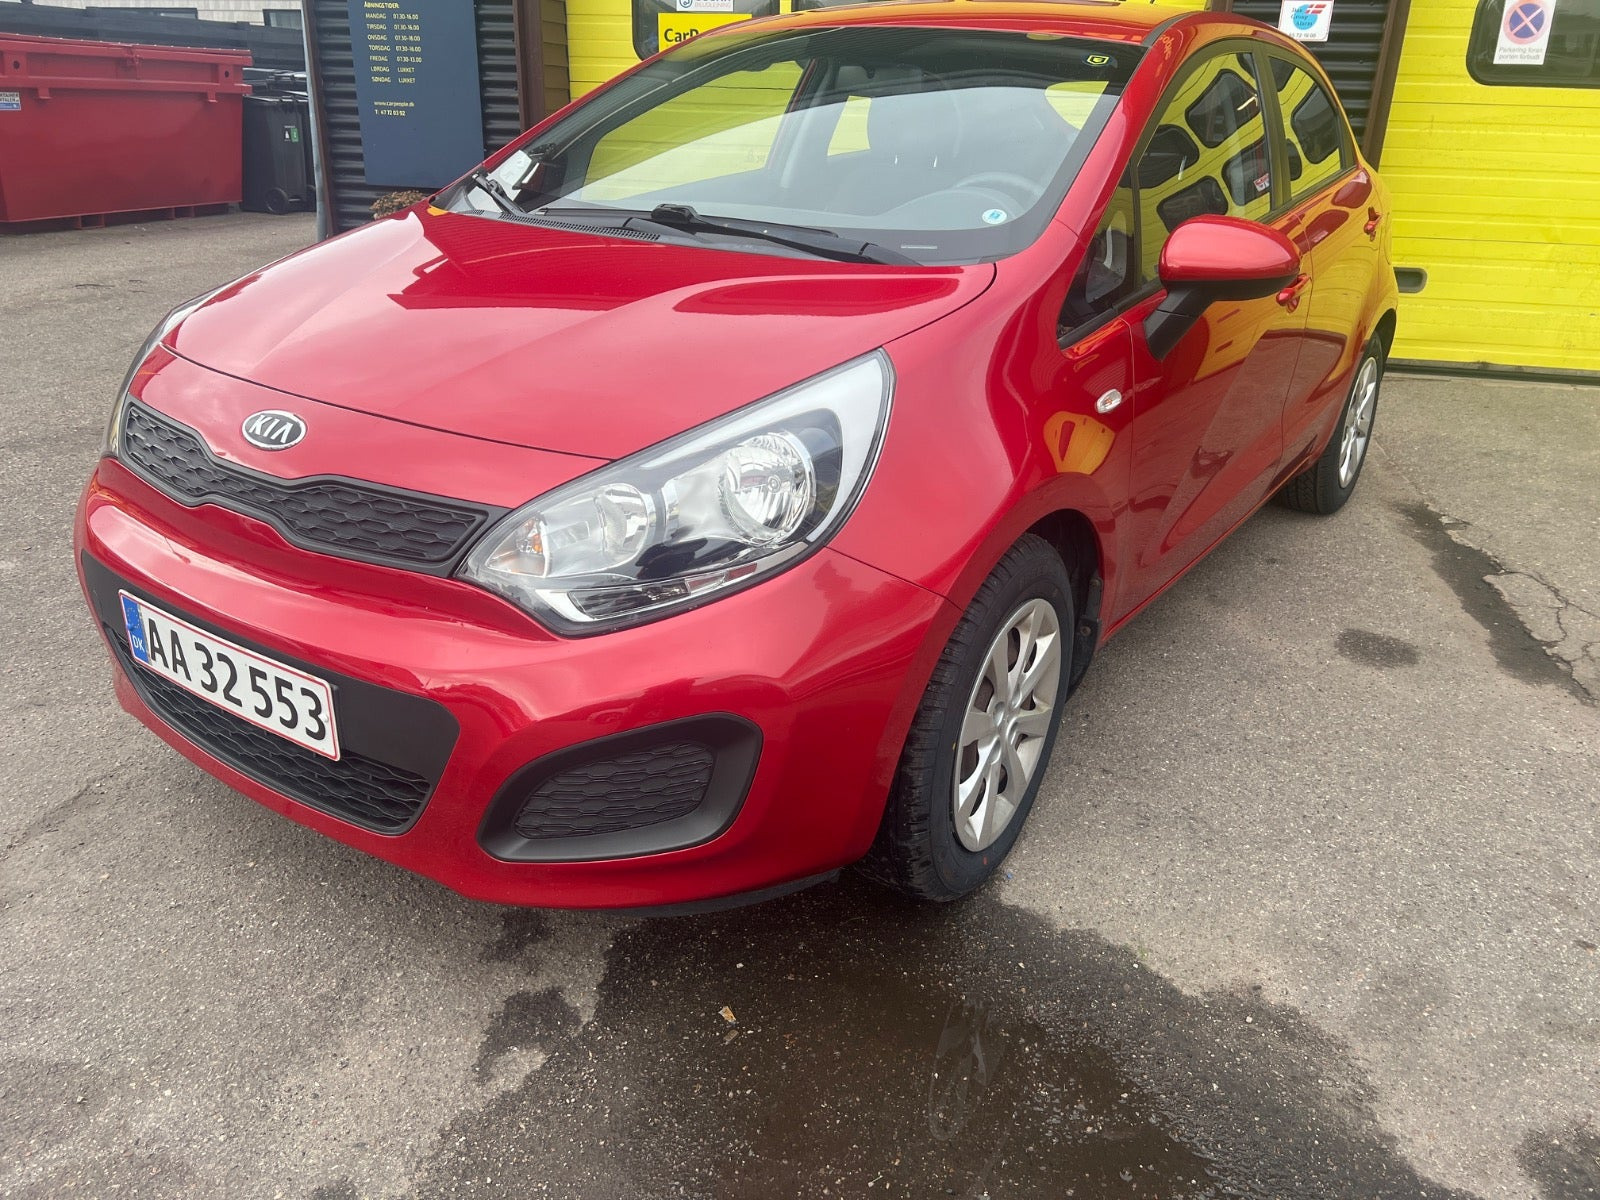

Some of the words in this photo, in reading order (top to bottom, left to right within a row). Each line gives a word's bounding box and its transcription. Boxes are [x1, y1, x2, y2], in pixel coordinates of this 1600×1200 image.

[248, 414, 294, 444] KIA
[131, 634, 146, 653] DK
[148, 617, 192, 683] AA
[194, 641, 243, 708] 32
[248, 665, 328, 742] 553
